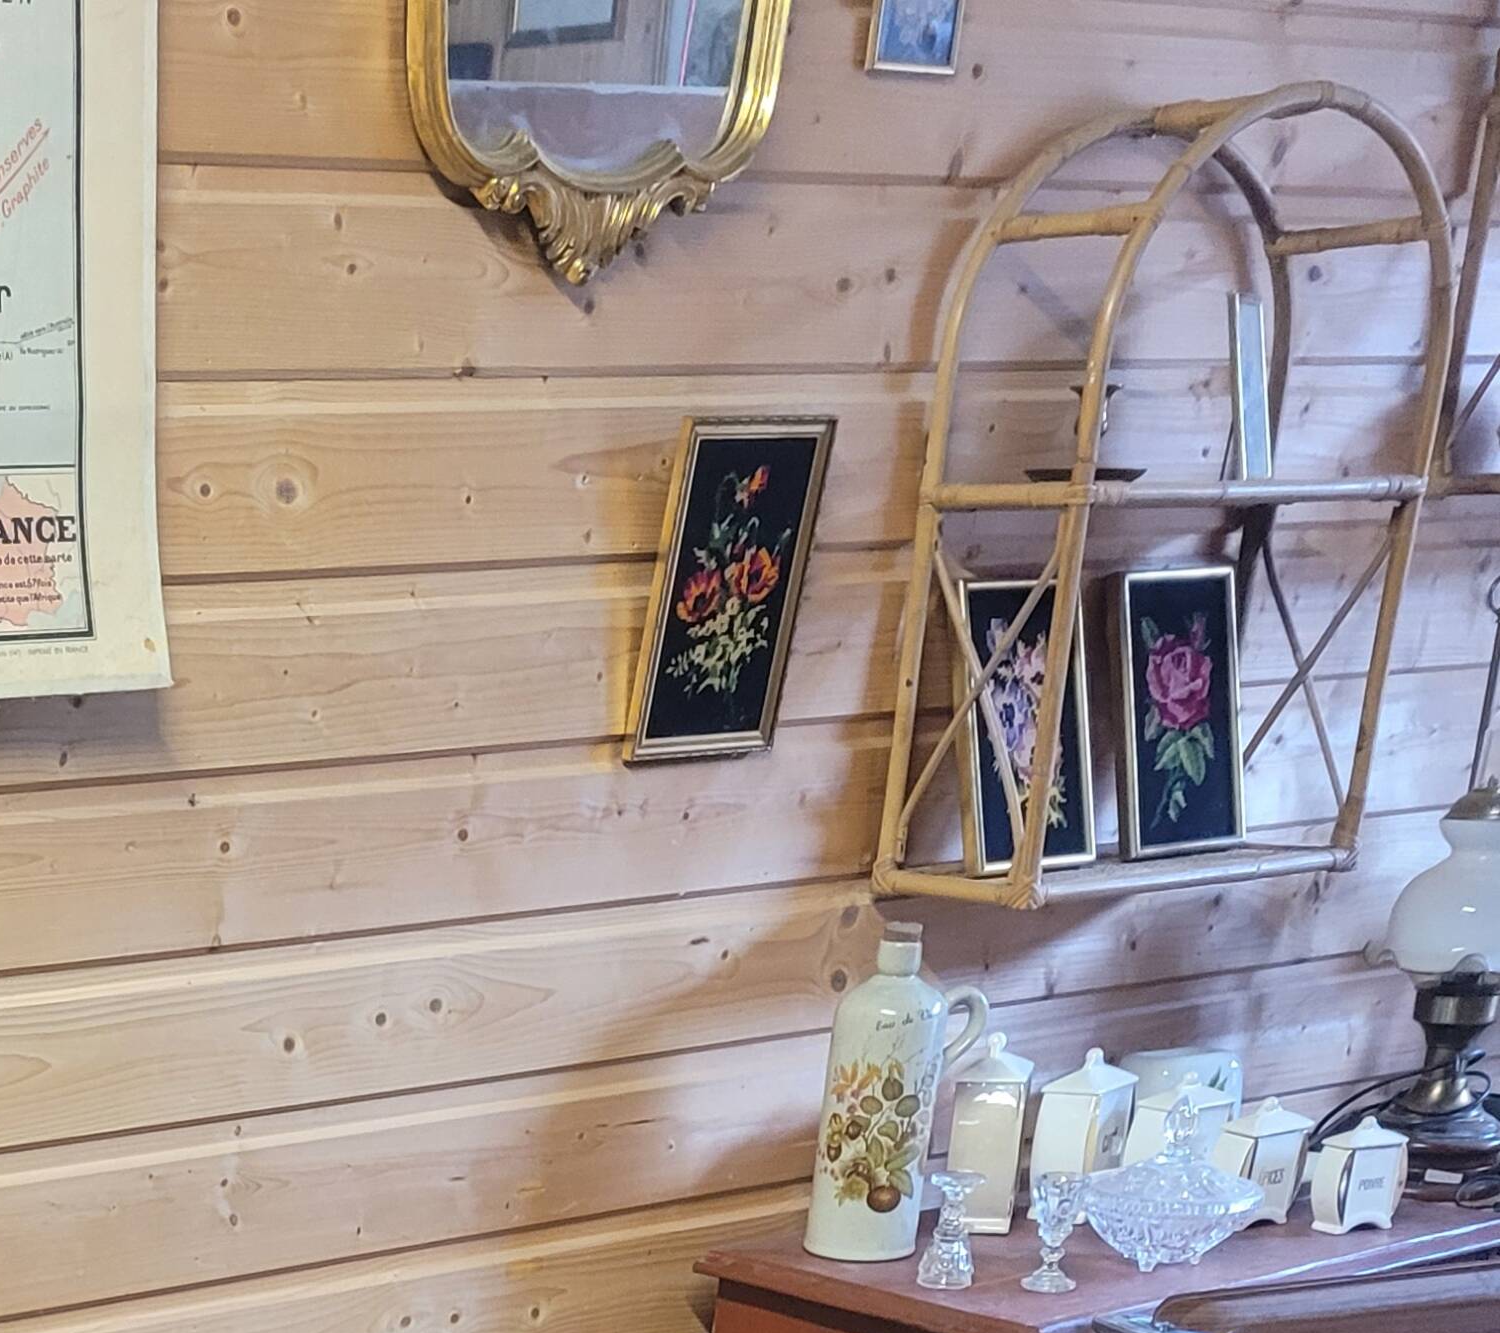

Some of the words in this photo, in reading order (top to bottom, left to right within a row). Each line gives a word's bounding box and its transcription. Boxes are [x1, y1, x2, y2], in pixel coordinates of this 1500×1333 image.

[1, 157, 50, 219] Graphite
[4, 552, 16, 566] de
[17, 553, 43, 565] cette
